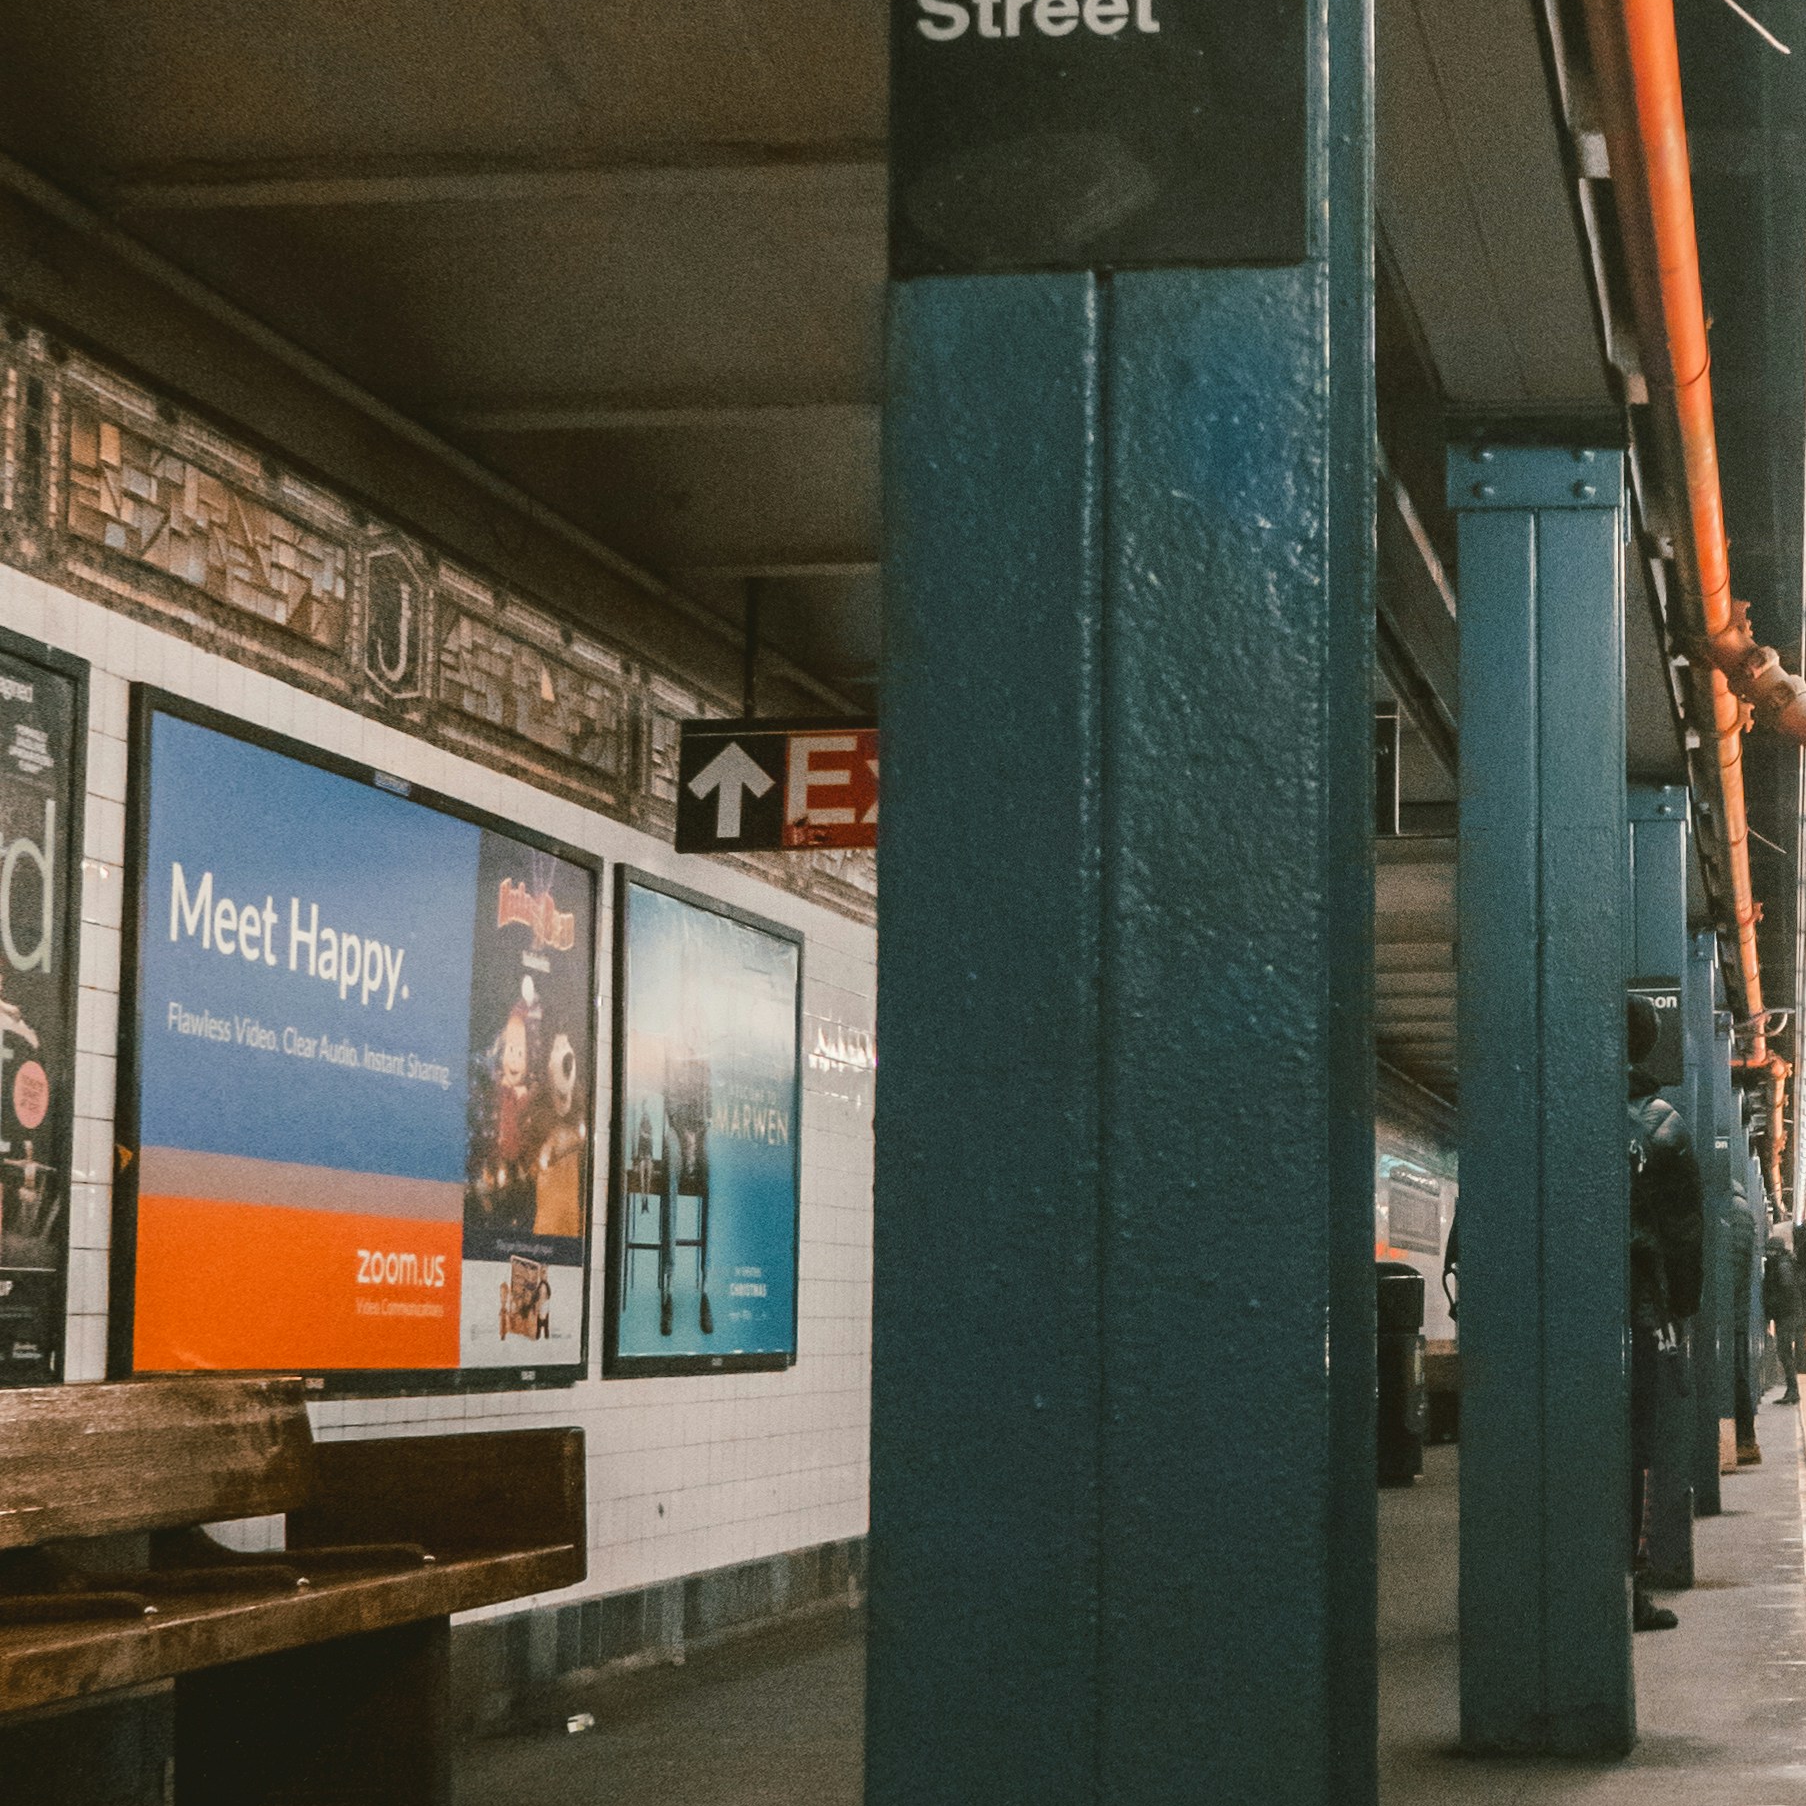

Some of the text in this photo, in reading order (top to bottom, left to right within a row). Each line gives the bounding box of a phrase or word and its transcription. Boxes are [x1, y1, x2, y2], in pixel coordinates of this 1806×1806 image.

[170, 861, 278, 967] Meet
[289, 896, 409, 1011] Happy.
[168, 1001, 232, 1043] Flawless
[283, 1026, 317, 1058] Clear
[364, 1043, 405, 1076] Instant
[713, 1105, 789, 1146] MARWEN
[357, 1249, 445, 1287] zoom.us
